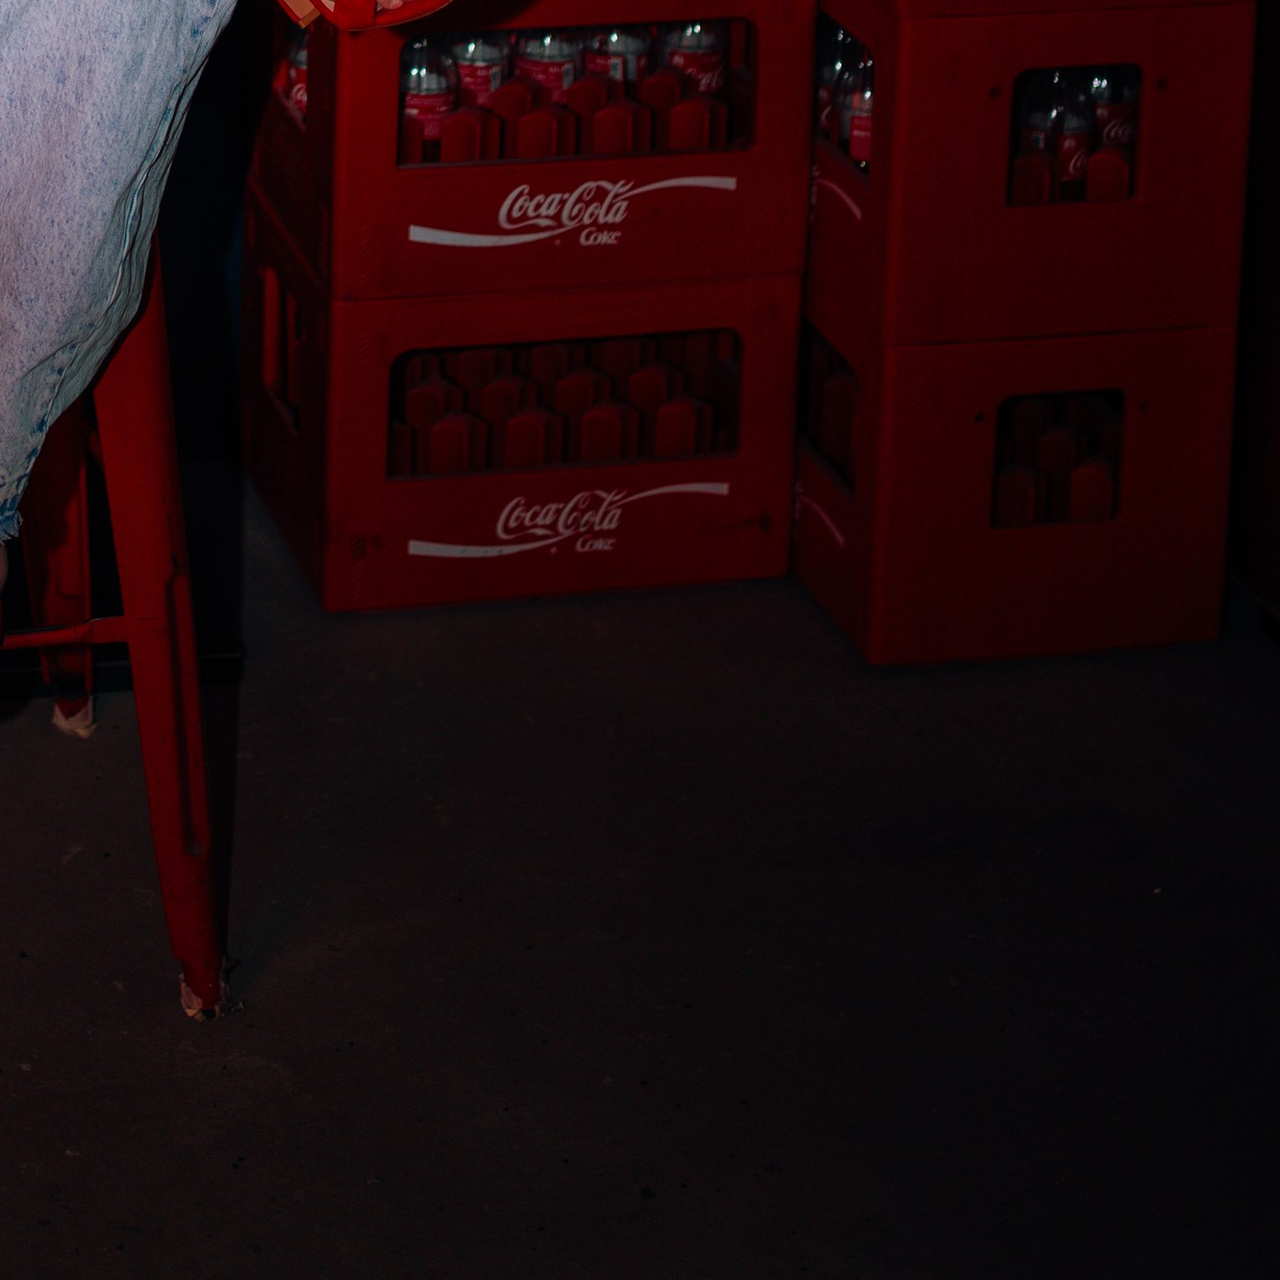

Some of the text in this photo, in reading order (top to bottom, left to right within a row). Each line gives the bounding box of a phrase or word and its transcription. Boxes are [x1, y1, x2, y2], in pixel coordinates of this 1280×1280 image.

[497, 179, 635, 230] Coca-Cola
[578, 226, 622, 247] Coke
[495, 488, 628, 540] Coca-Cola
